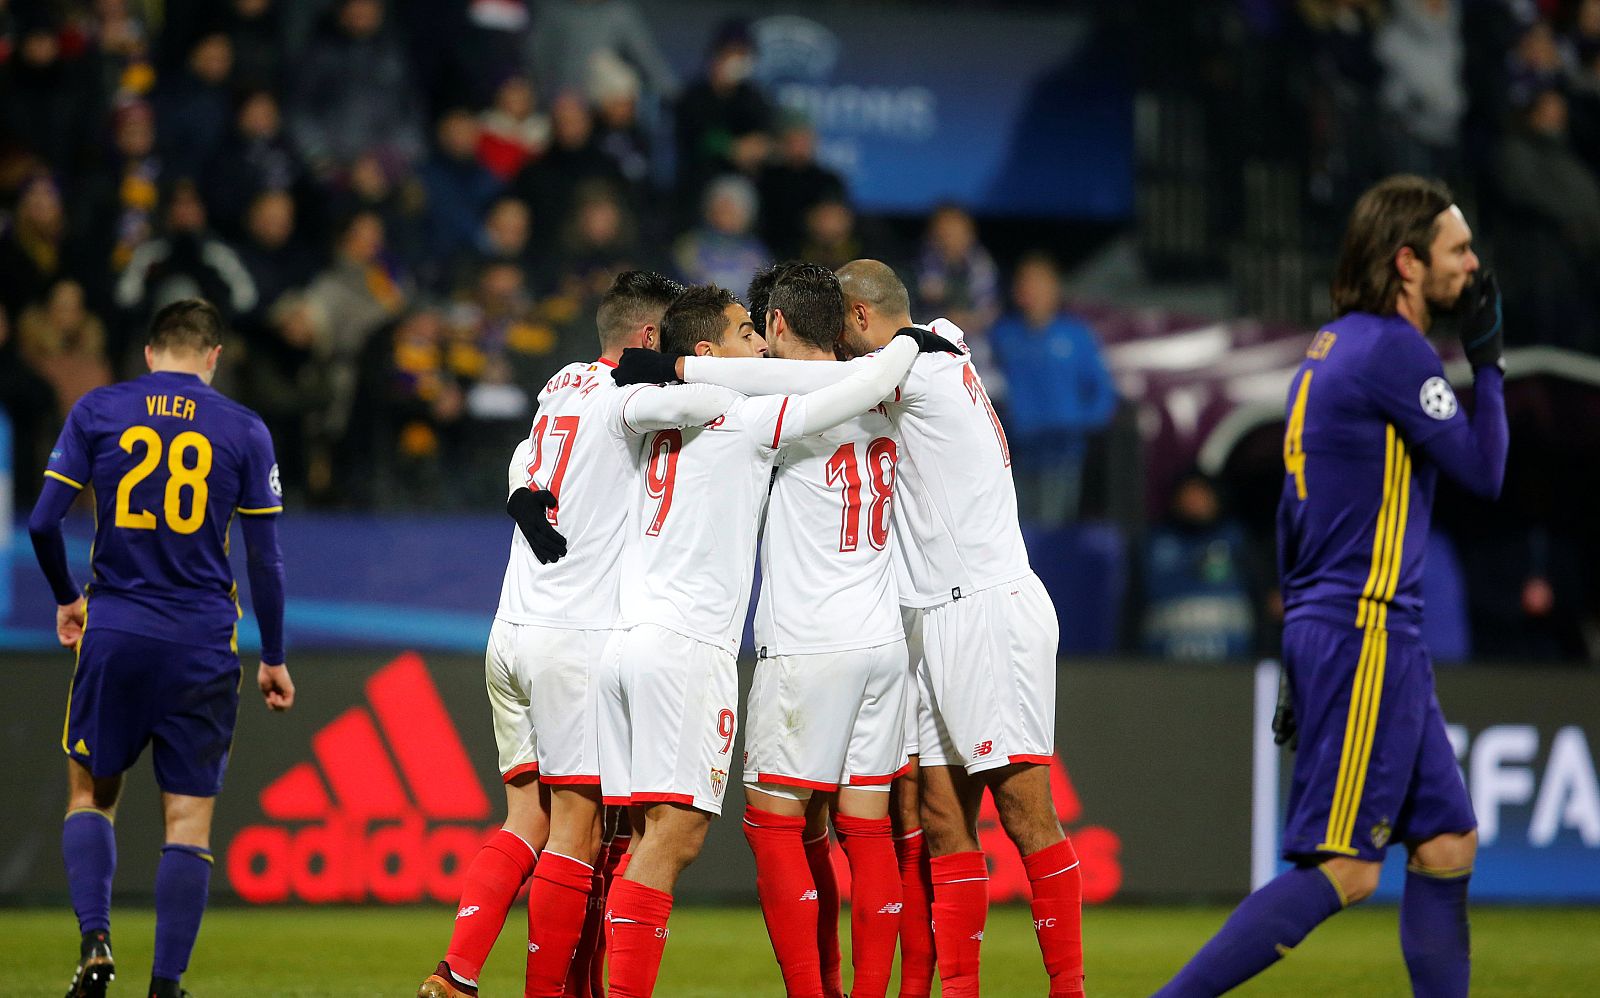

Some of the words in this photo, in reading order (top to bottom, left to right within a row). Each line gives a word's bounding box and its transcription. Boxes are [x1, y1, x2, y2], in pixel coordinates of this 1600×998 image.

[146, 394, 197, 422] VILER
[1284, 368, 1309, 500] 4
[115, 425, 213, 535] 28
[645, 428, 683, 537] 9
[825, 436, 898, 552] 18
[716, 708, 735, 756] 9
[226, 808, 536, 905] adida
